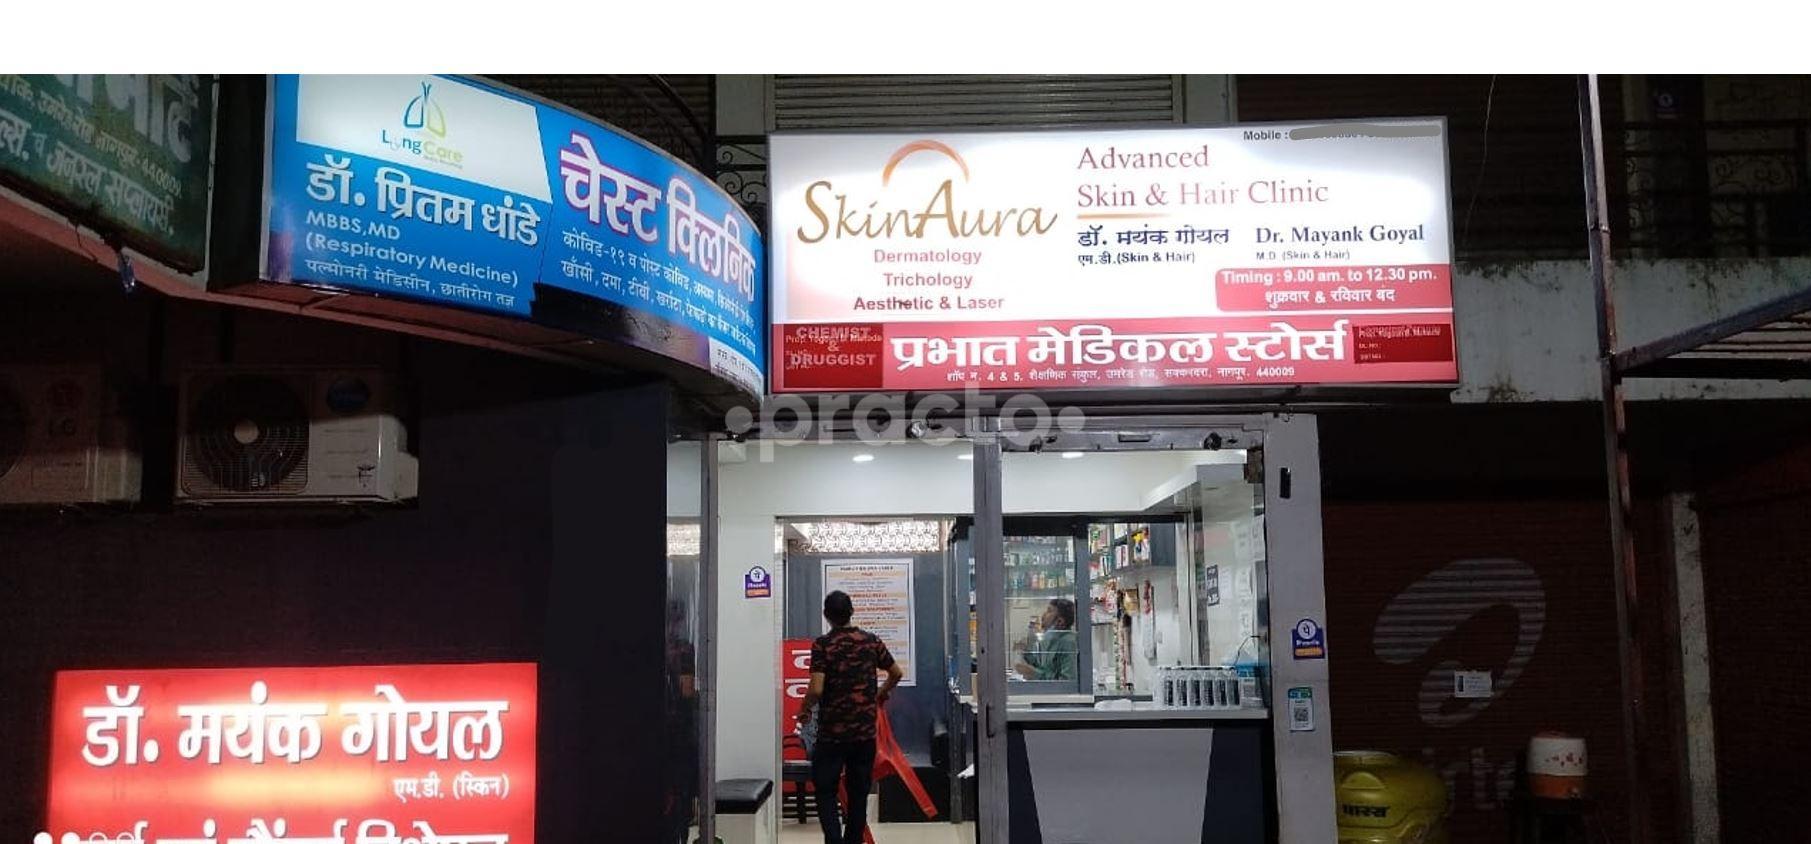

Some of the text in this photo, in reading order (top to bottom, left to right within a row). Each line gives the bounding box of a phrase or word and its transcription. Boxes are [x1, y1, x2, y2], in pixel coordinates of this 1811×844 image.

[1243, 130, 1282, 141] Mobile
[1077, 145, 1210, 170] Advanced
[306, 153, 541, 247] डॉ. प्रितम धांडे
[1077, 178, 1329, 208] Skin & Hair Clinic
[560, 133, 757, 303] चेस्ट क्लिनिक
[797, 179, 1058, 244] SkinAura
[305, 209, 401, 241] MBBS,MD
[1077, 223, 1230, 247] डॉ. मयंक गोयल
[1255, 223, 1424, 246] Dr. Mayank Goyal
[305, 232, 519, 288] (Respiratory Medicine)
[874, 249, 982, 265] Dermatology
[1152, 252, 1162, 262] &
[1165, 251, 1195, 264] Hair)
[1313, 250, 1321, 260] &
[1324, 249, 1350, 261] Hair)
[883, 272, 973, 288] Trichology
[1222, 270, 1273, 286] Timing
[1283, 270, 1314, 283] 9.00
[1317, 270, 1345, 283] am.
[1348, 269, 1363, 282] to
[1366, 268, 1406, 282] 12.30
[1408, 268, 1438, 283] pm.
[853, 296, 1004, 311] Aesthetic & Laser
[1264, 288, 1310, 309] शुक्रवार
[1315, 291, 1326, 303] &
[1330, 286, 1372, 302] रविवार
[796, 327, 871, 339] CHEMIST
[890, 318, 1349, 371] प्रभात मेडिकल स्टोर्स
[827, 340, 840, 352] &
[790, 353, 877, 366] DRUGGIST
[987, 372, 994, 381] 4
[1000, 371, 1008, 382] &
[1256, 365, 1295, 378] 440009
[82, 680, 510, 767] डॉ. मयंक गोयल
[452, 771, 510, 800] (स्किन)
